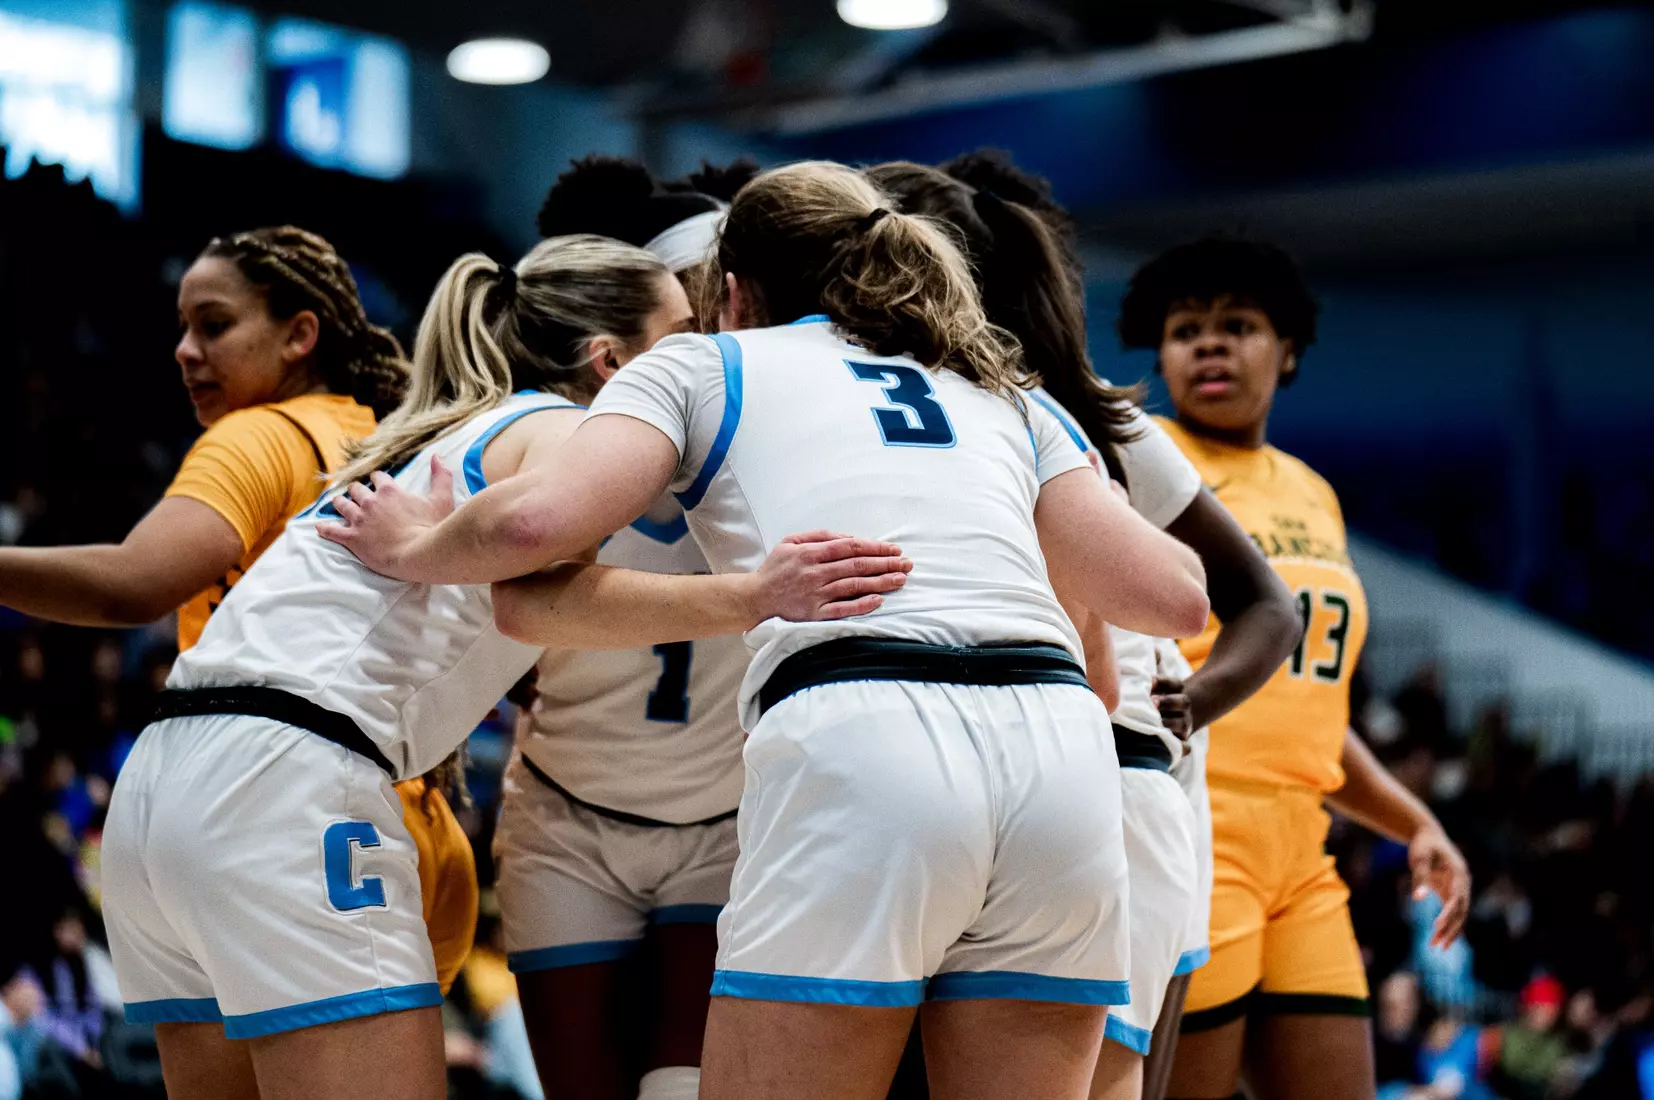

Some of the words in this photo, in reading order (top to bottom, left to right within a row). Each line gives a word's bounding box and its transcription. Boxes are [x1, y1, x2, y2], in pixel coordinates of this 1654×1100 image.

[842, 359, 957, 448] 3
[1289, 588, 1350, 681] 13
[323, 820, 387, 911] C
